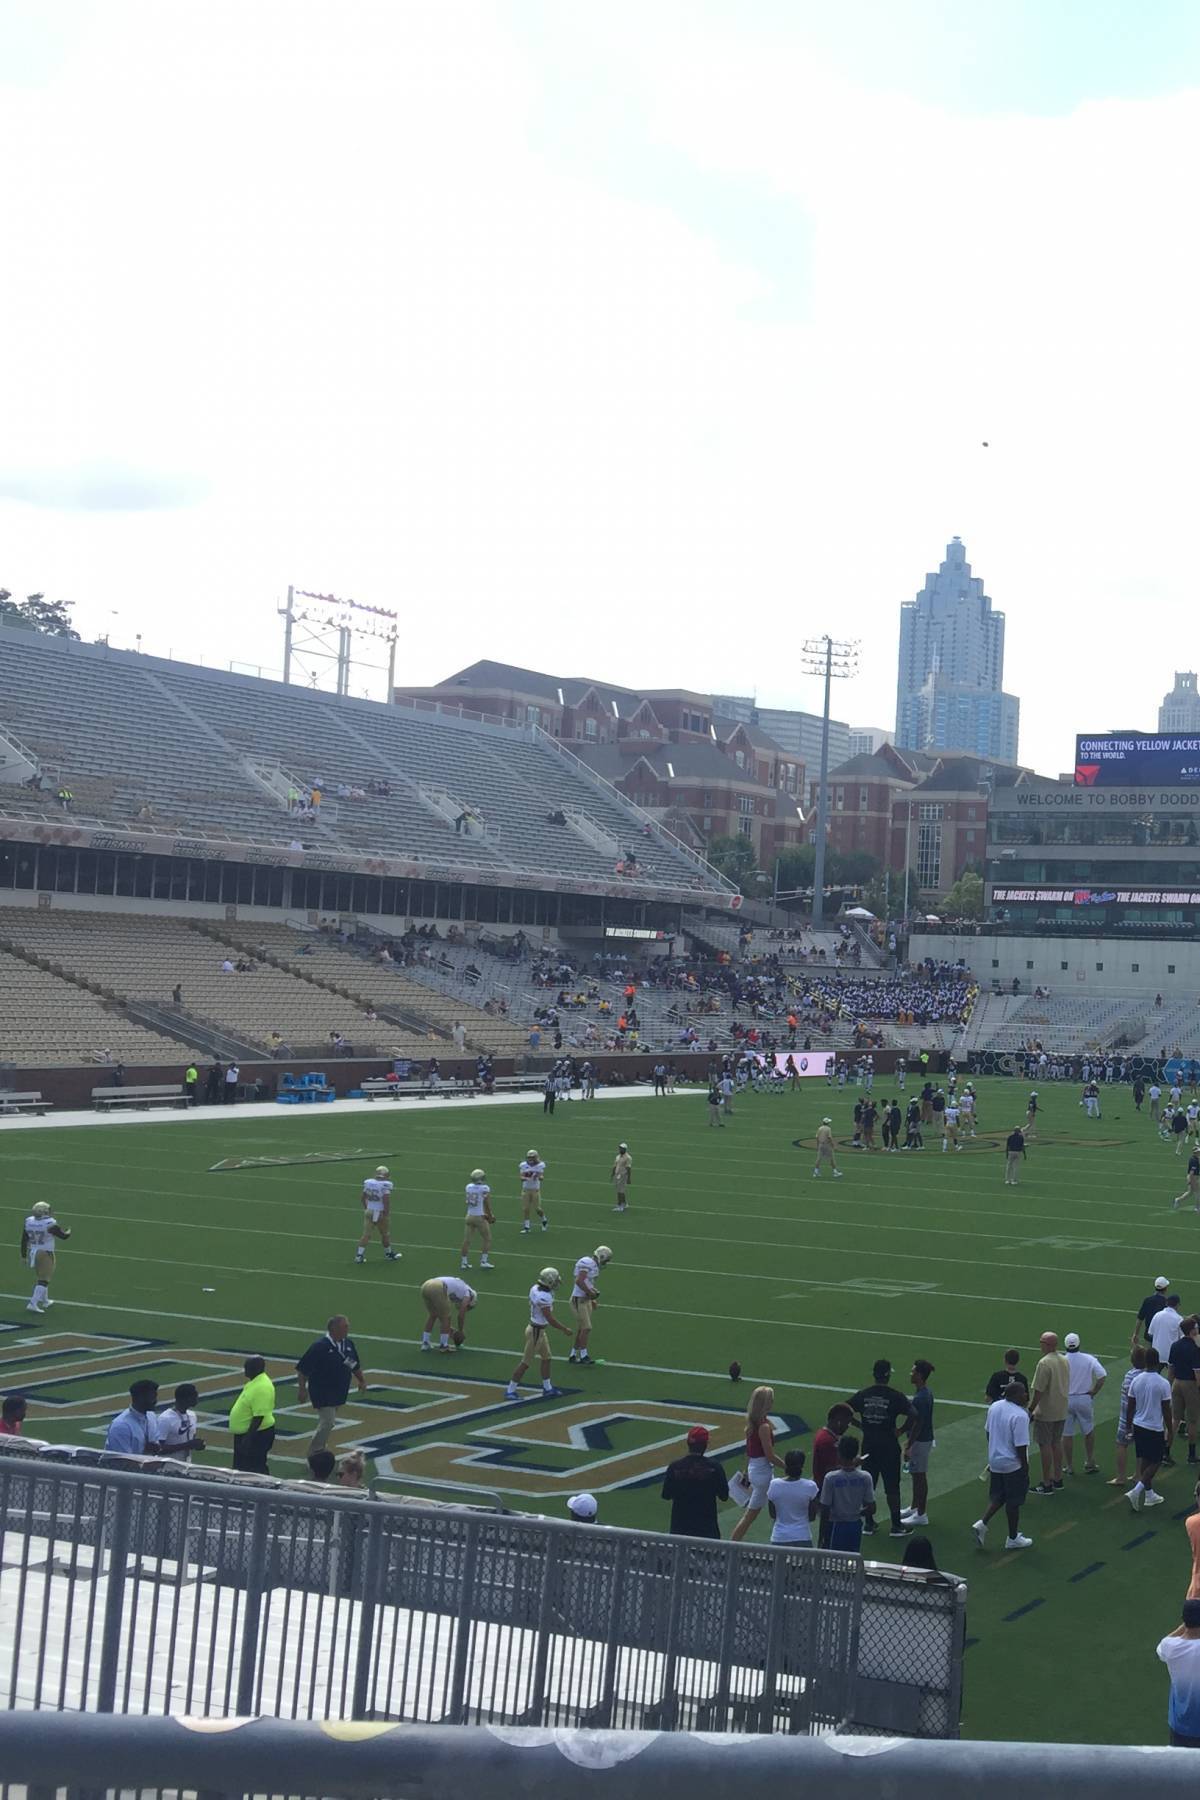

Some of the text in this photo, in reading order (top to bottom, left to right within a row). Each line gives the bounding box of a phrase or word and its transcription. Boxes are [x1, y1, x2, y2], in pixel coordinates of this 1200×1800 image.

[1080, 741, 1134, 751] CONNECTING
[1136, 740, 1171, 750] YELLOW
[1017, 793, 1083, 805] WELCOME
[1088, 793, 1106, 805] TO
[1110, 793, 1156, 805] BOBBY
[1160, 793, 1200, 805] DODD
[993, 890, 1006, 900] THE
[1007, 890, 1036, 901] JACKETS
[1036, 891, 1063, 902] SWARM
[1064, 892, 1074, 902] ON
[1117, 892, 1130, 902] THE
[1130, 892, 1161, 903] JACKETS
[1162, 893, 1189, 903] SWARM
[1190, 893, 1200, 904] ON
